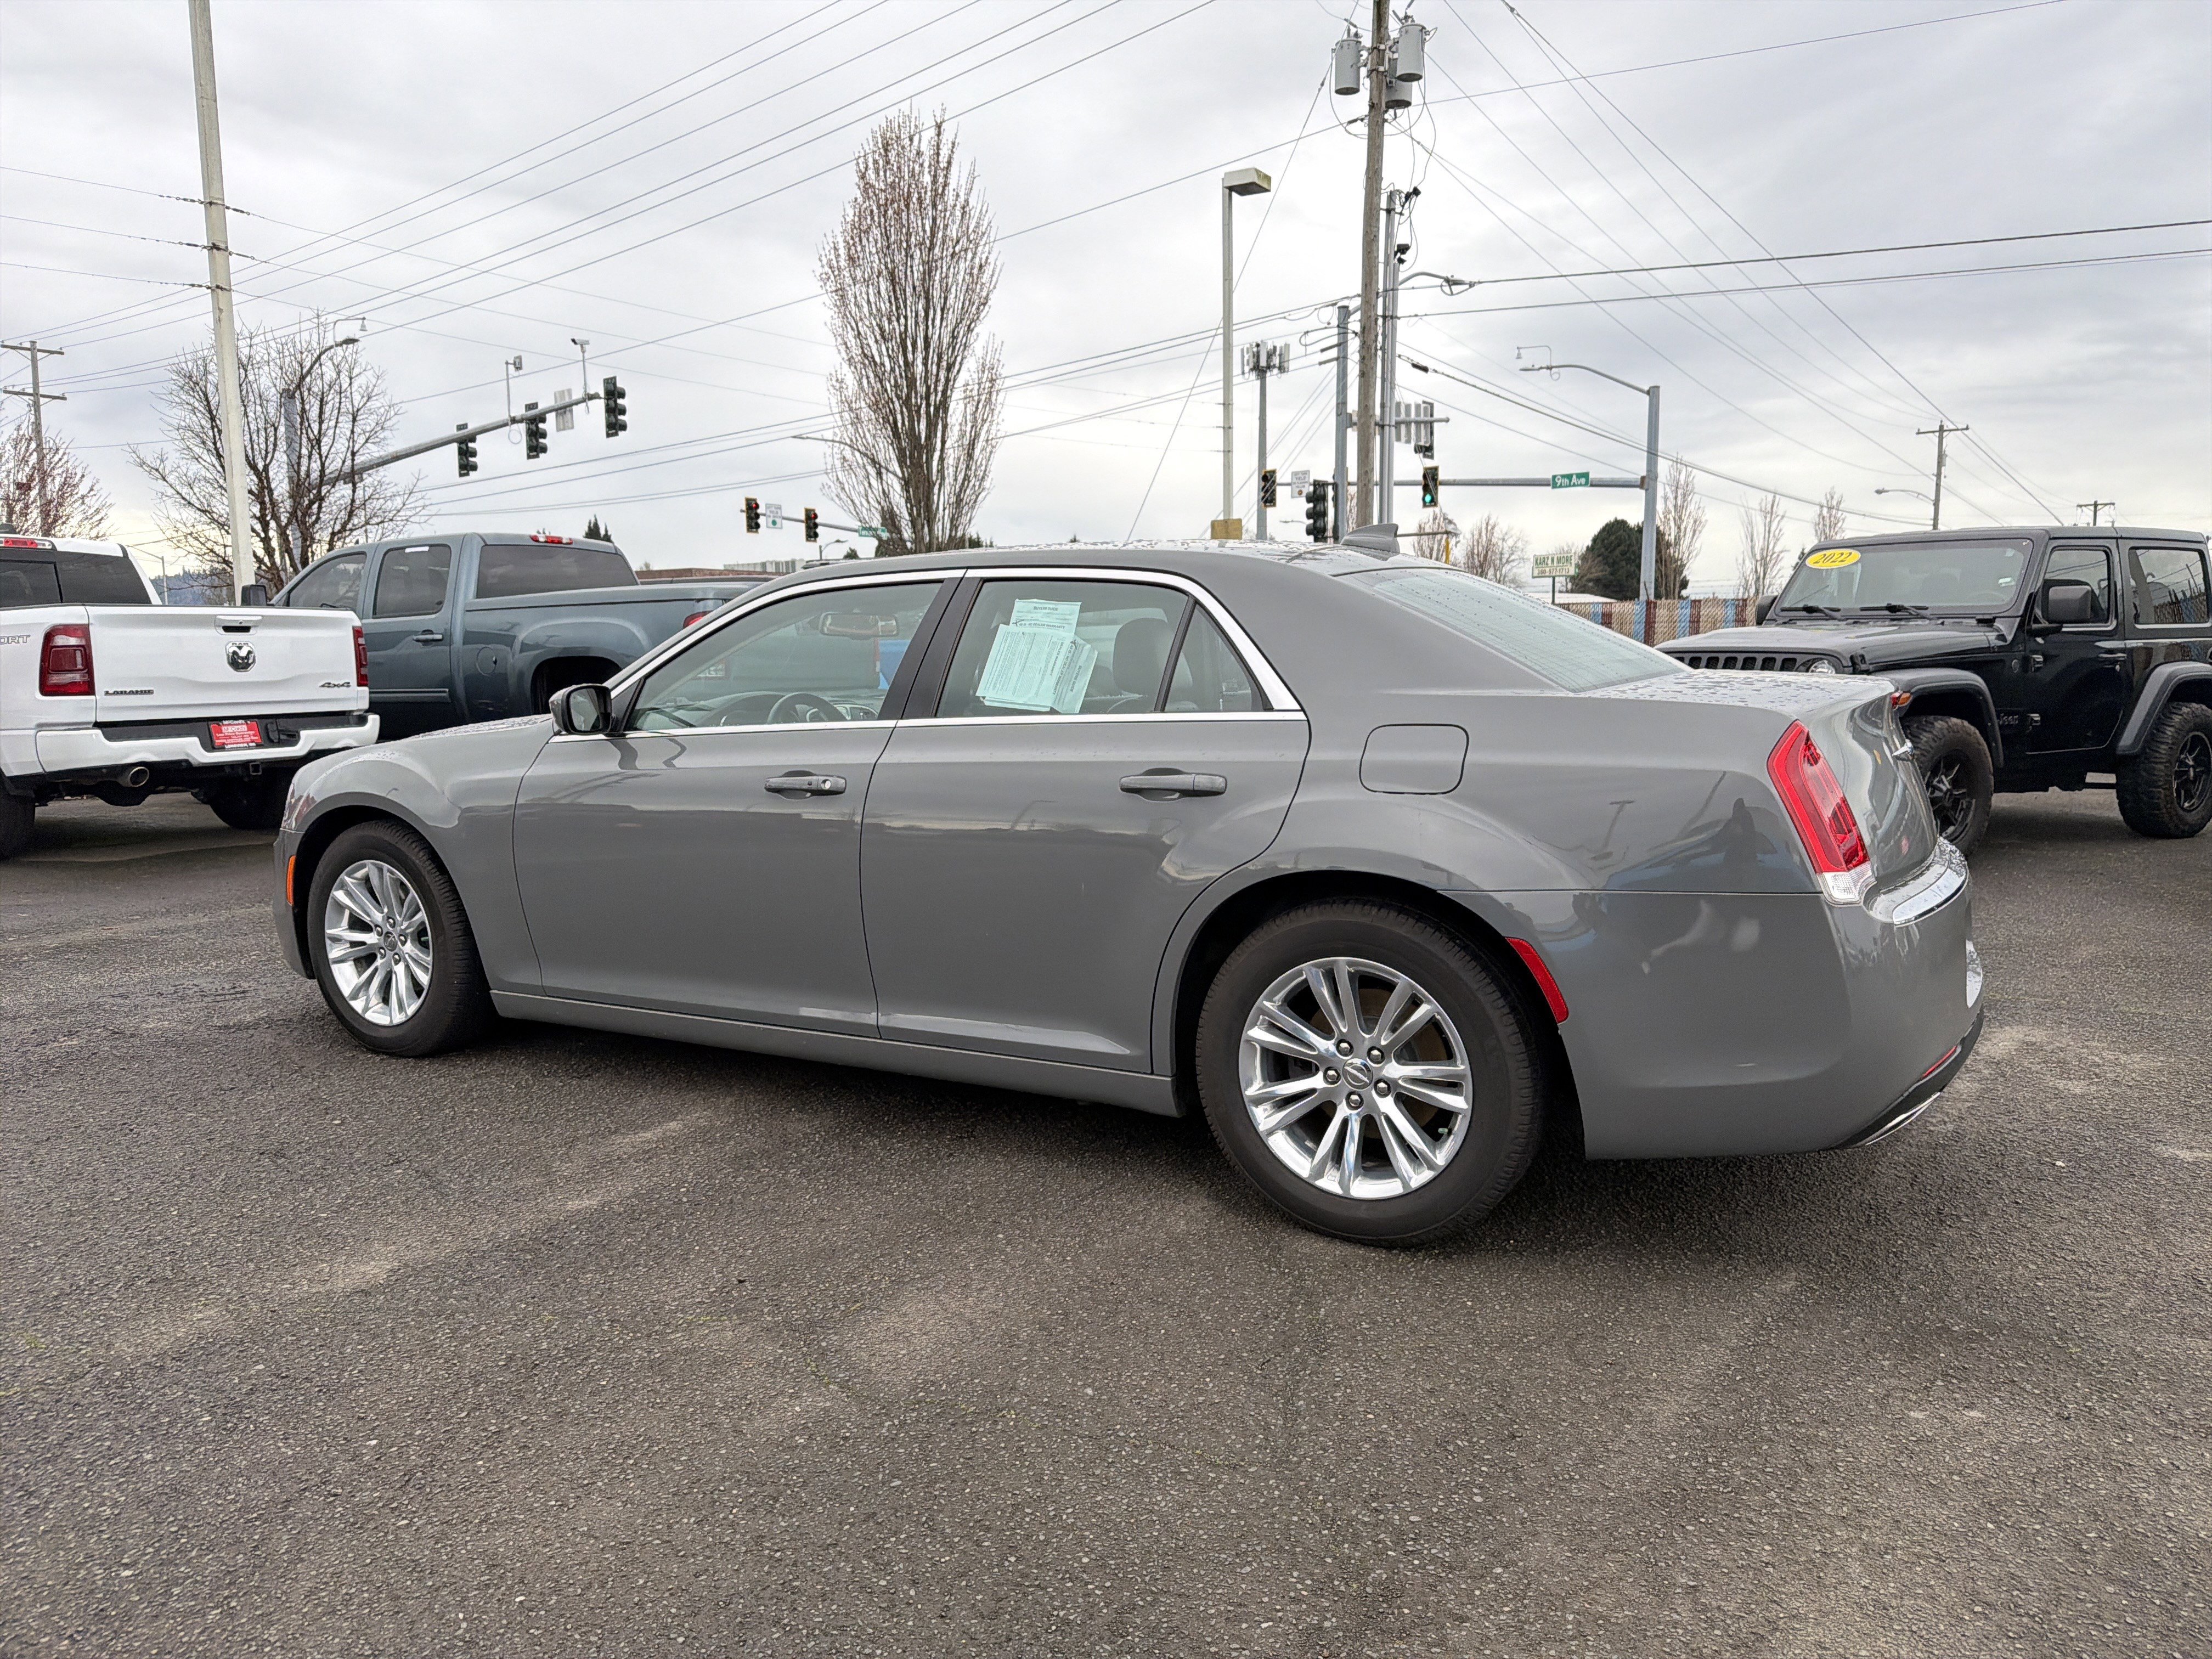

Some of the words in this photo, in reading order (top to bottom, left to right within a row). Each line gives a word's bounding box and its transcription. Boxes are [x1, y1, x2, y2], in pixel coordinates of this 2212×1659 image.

[1555, 475, 1569, 487] 9th
[1571, 474, 1586, 486] Ave
[1535, 556, 1549, 566] KARZ
[1551, 556, 1555, 565] N
[1556, 555, 1573, 565] MORE
[1813, 552, 1852, 565] 2022
[1997, 713, 2019, 725] Jeep
